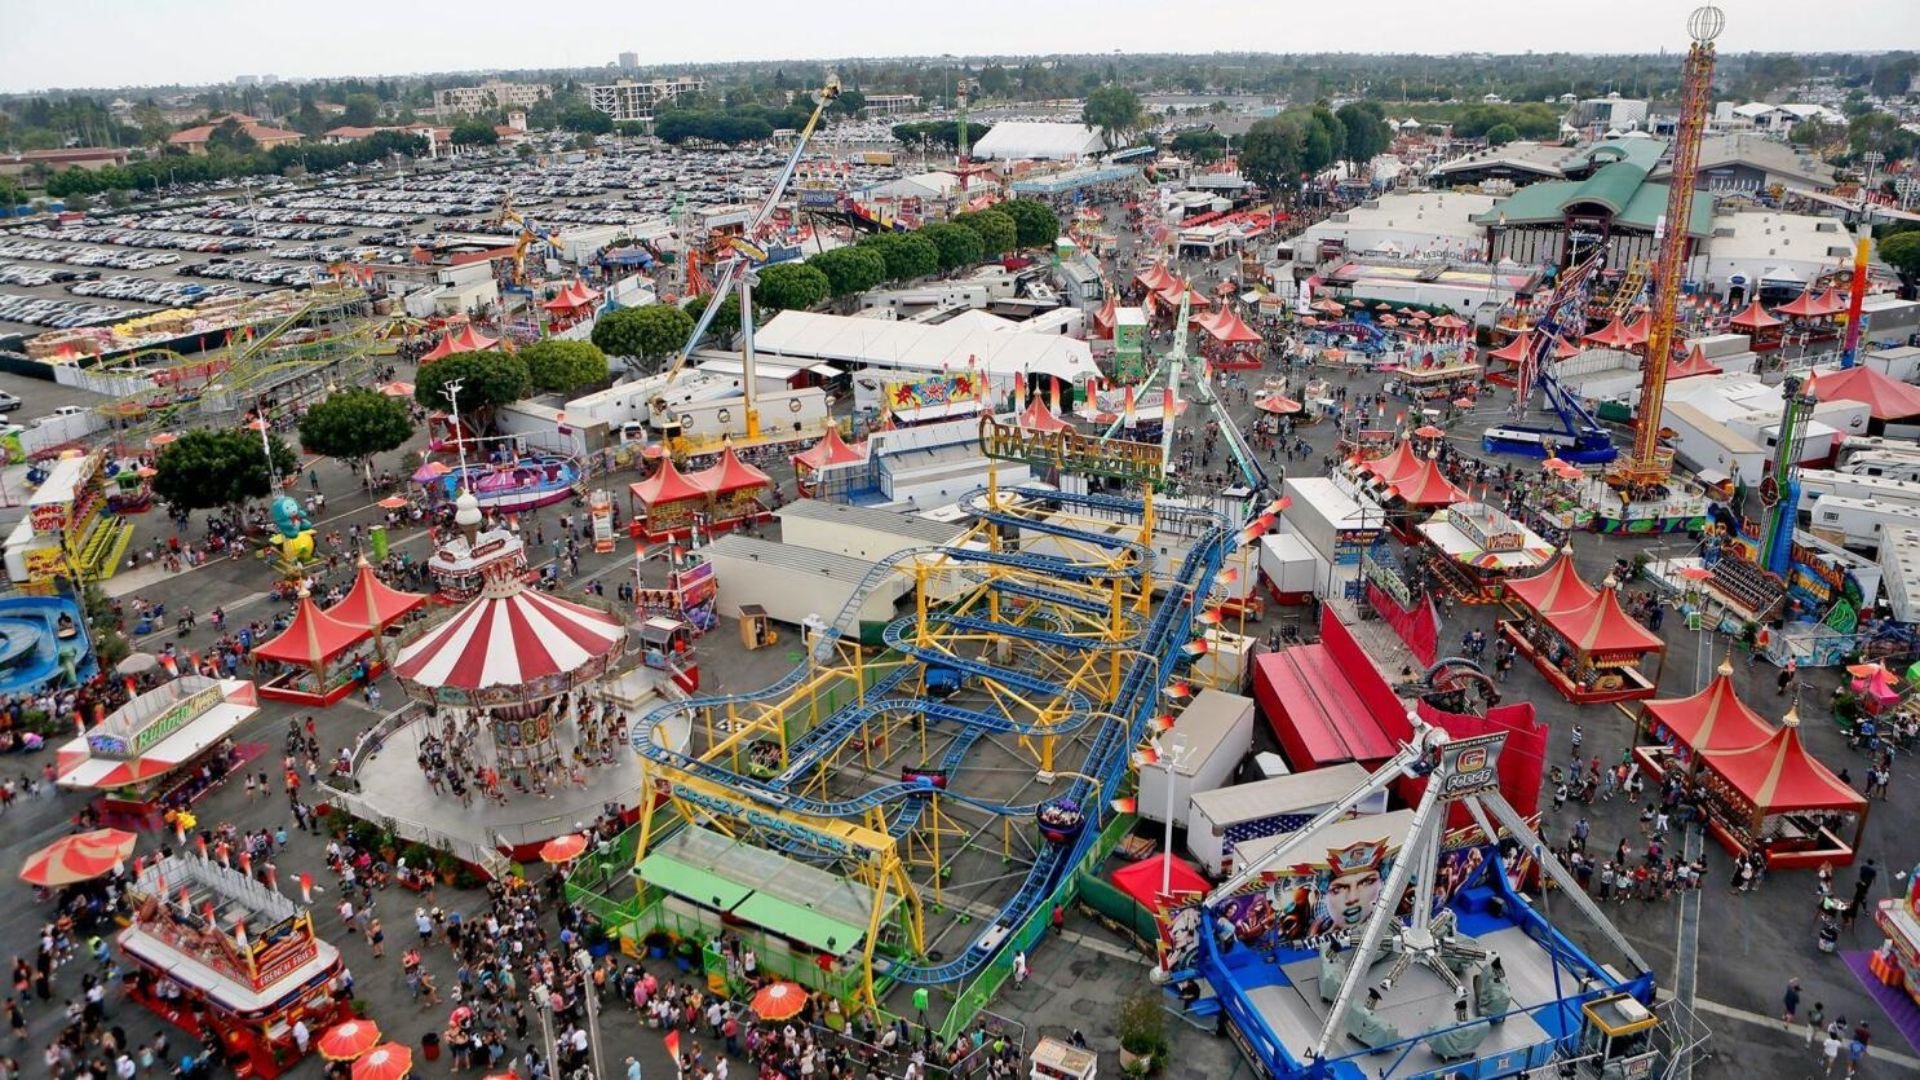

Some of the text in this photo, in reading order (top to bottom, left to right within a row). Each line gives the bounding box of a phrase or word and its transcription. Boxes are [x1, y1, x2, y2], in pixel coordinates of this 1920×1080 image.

[979, 414, 1057, 460] CRAZY
[672, 782, 849, 857] CRAZY COASTER
[260, 962, 291, 986] FRENCH
